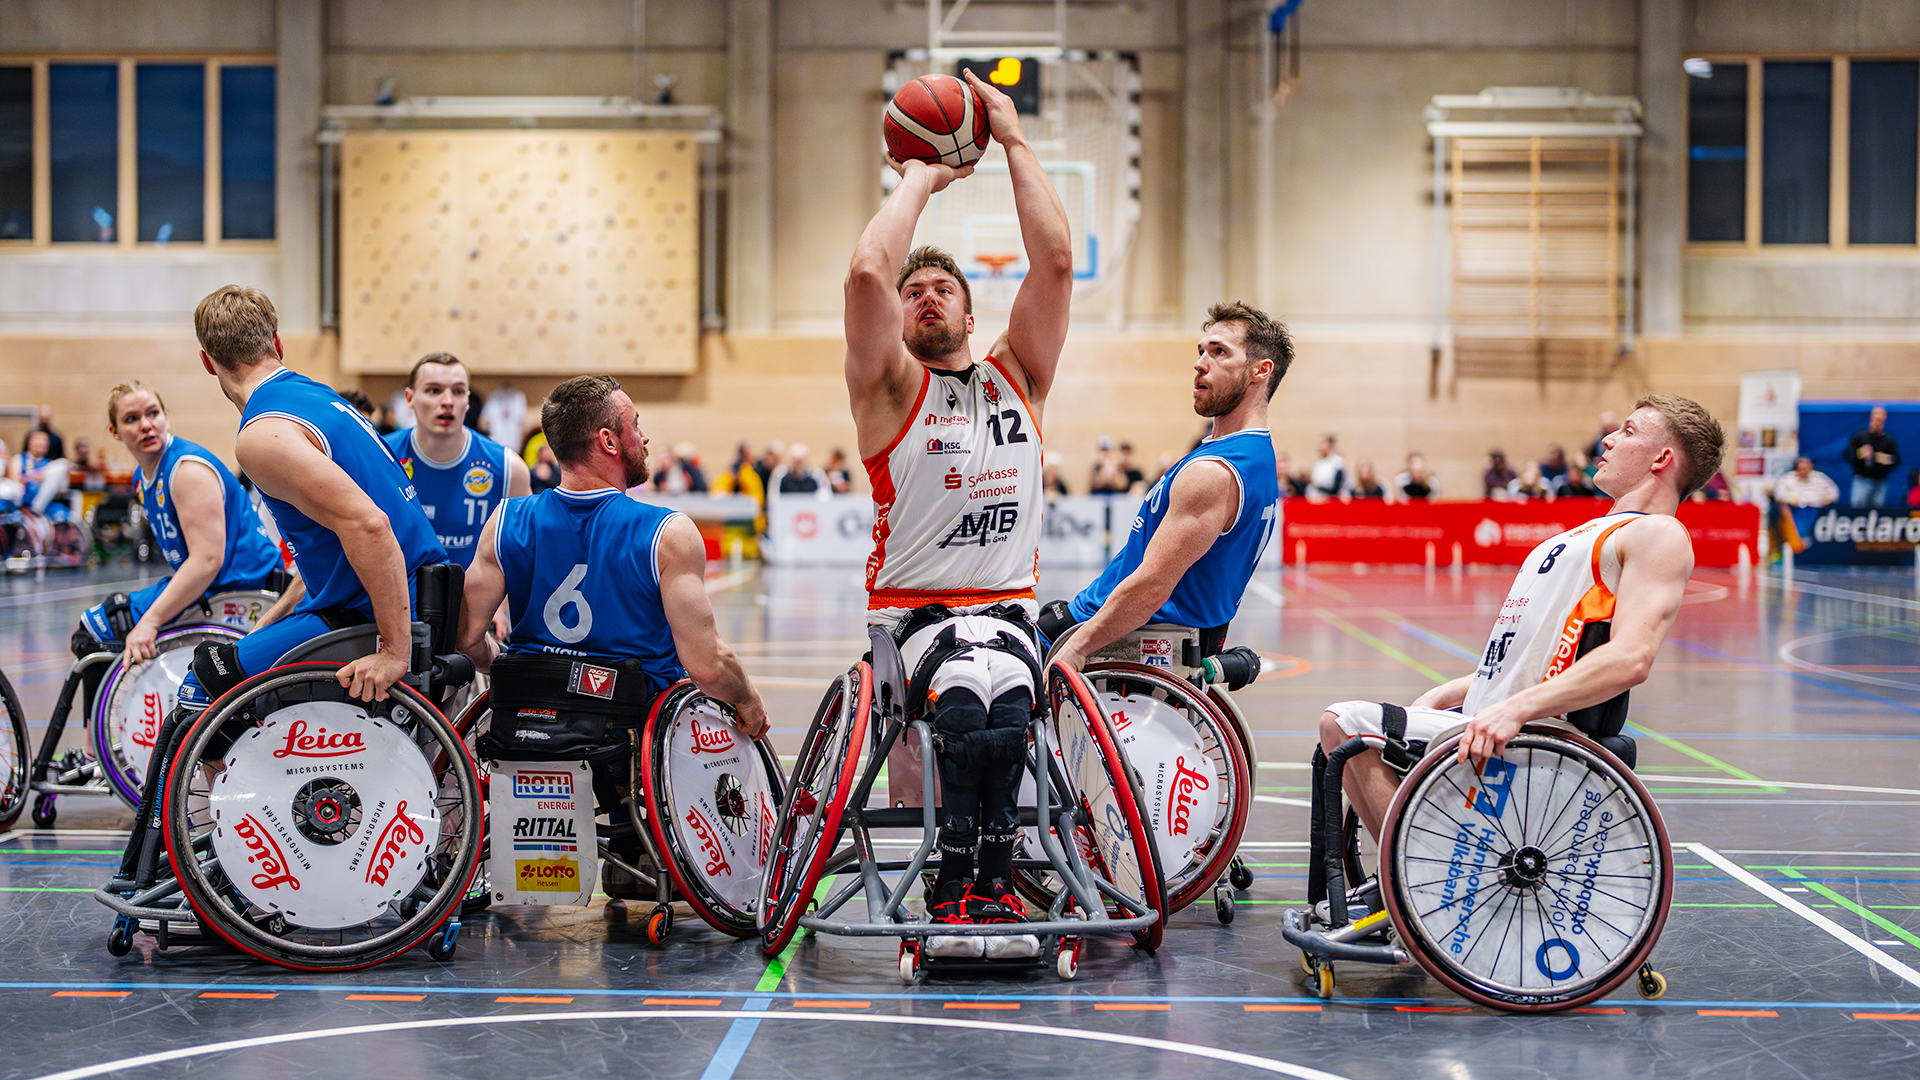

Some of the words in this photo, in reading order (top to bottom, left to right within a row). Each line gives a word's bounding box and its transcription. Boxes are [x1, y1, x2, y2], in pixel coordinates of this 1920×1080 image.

[944, 442, 960, 450] KSG
[987, 409, 1028, 446] 12
[968, 467, 1018, 488] Sarkasse
[969, 484, 1017, 500] annover
[156, 512, 178, 540] 15
[464, 498, 488, 526] 11
[937, 502, 1019, 549] MTB
[543, 564, 593, 643] 6
[588, 668, 610, 677] RDX
[273, 720, 367, 759] Leica
[690, 719, 735, 755] Leica
[286, 762, 365, 775] MICROSYSTEMS
[703, 756, 740, 770] MICROSYSTEMS
[517, 775, 570, 794] ROTH
[1152, 762, 1165, 831] MICROSYSTEMS
[1167, 755, 1210, 837] Leica
[537, 801, 575, 810] ENERGIE
[261, 804, 312, 871] MICROSYSTEMS
[349, 800, 386, 872] MICROSYSTEMS
[365, 800, 424, 888] Leica
[513, 817, 577, 837] RITTAL
[685, 805, 732, 877] Leica
[699, 797, 736, 857] MICROSYSTEMS
[234, 813, 301, 891] Leica
[1440, 823, 1476, 912] Volksbank
[1546, 789, 1601, 931] john+bamberg
[536, 865, 575, 879] LOTTO
[1450, 827, 1497, 955] Hannoversche
[1571, 811, 1614, 935] ottobock.care
